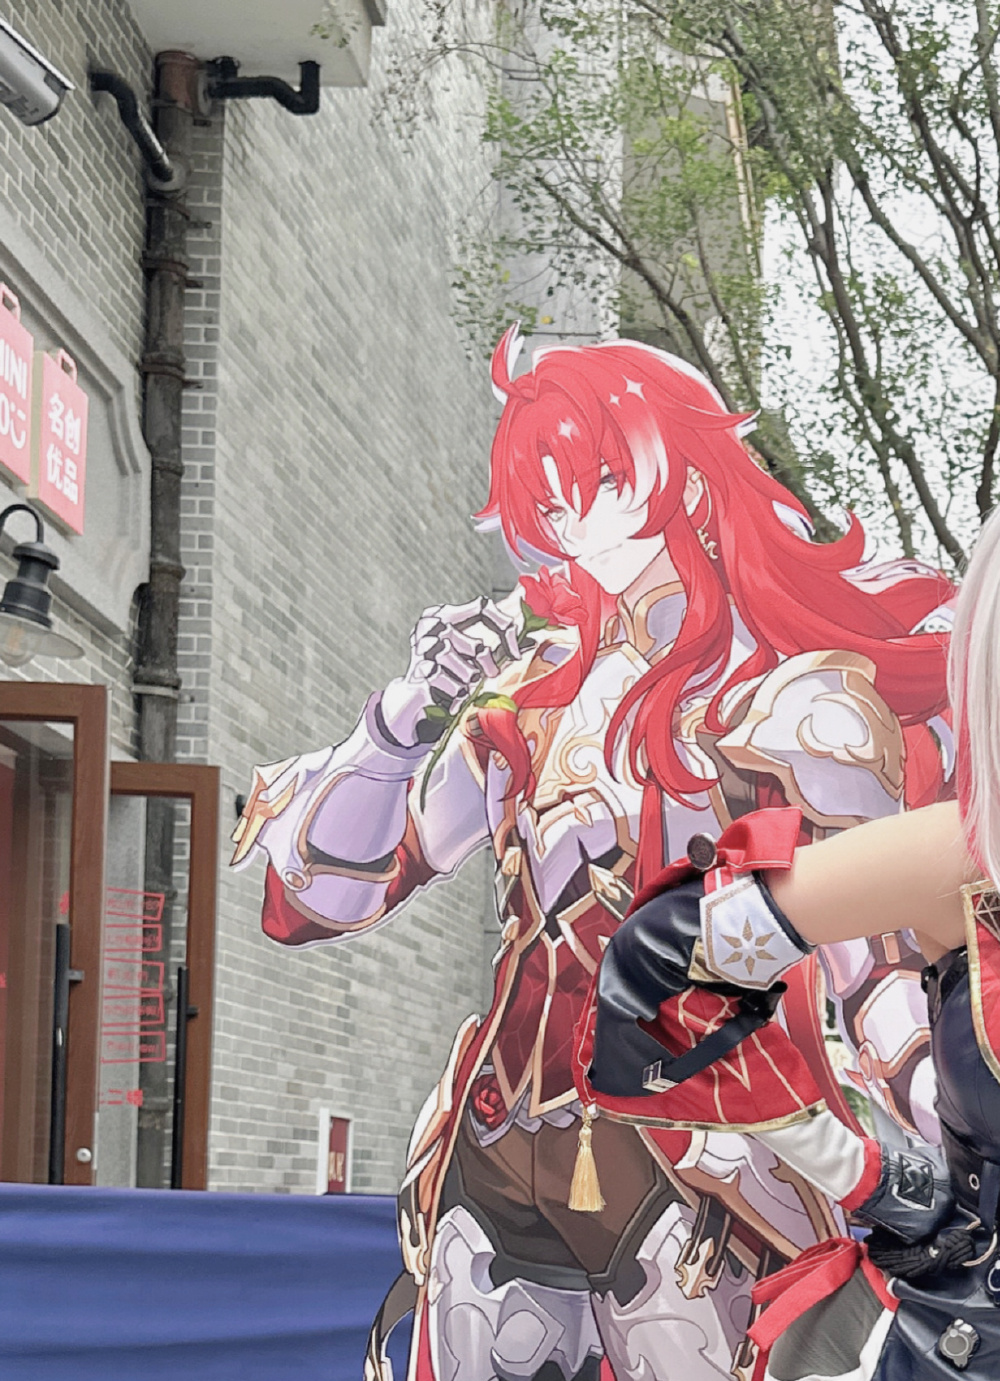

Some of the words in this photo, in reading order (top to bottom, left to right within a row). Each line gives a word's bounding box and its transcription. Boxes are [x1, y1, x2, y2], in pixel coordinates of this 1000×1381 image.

[0, 338, 27, 399] INI
[48, 393, 81, 455] 名创
[46, 442, 78, 505] 优品
